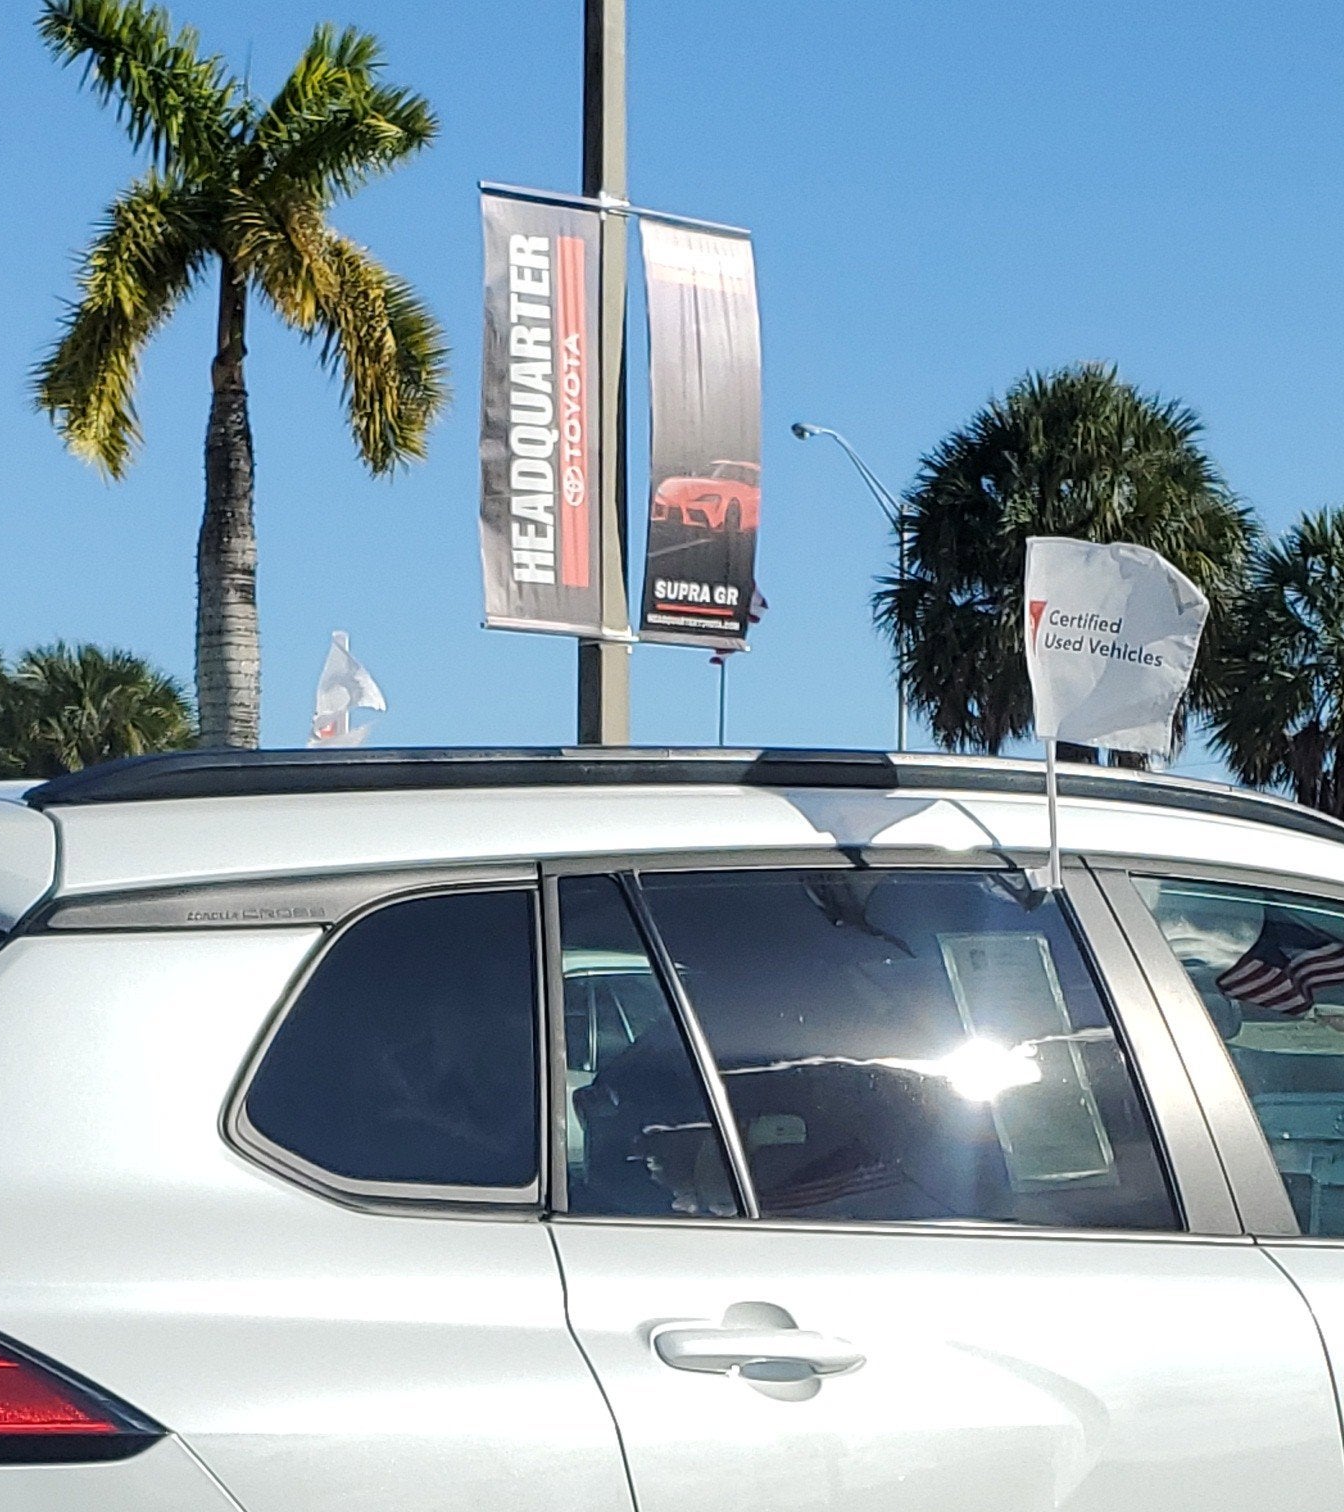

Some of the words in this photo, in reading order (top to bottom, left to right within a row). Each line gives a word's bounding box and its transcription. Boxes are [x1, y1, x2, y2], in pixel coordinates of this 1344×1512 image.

[508, 234, 559, 585] HEADQUARTER
[563, 332, 583, 463] TOYOTA
[655, 579, 711, 603] SUPRA
[714, 586, 739, 606] GR
[1049, 609, 1123, 635] Certified
[1044, 632, 1084, 652] Used
[1089, 638, 1164, 667] Vehicles
